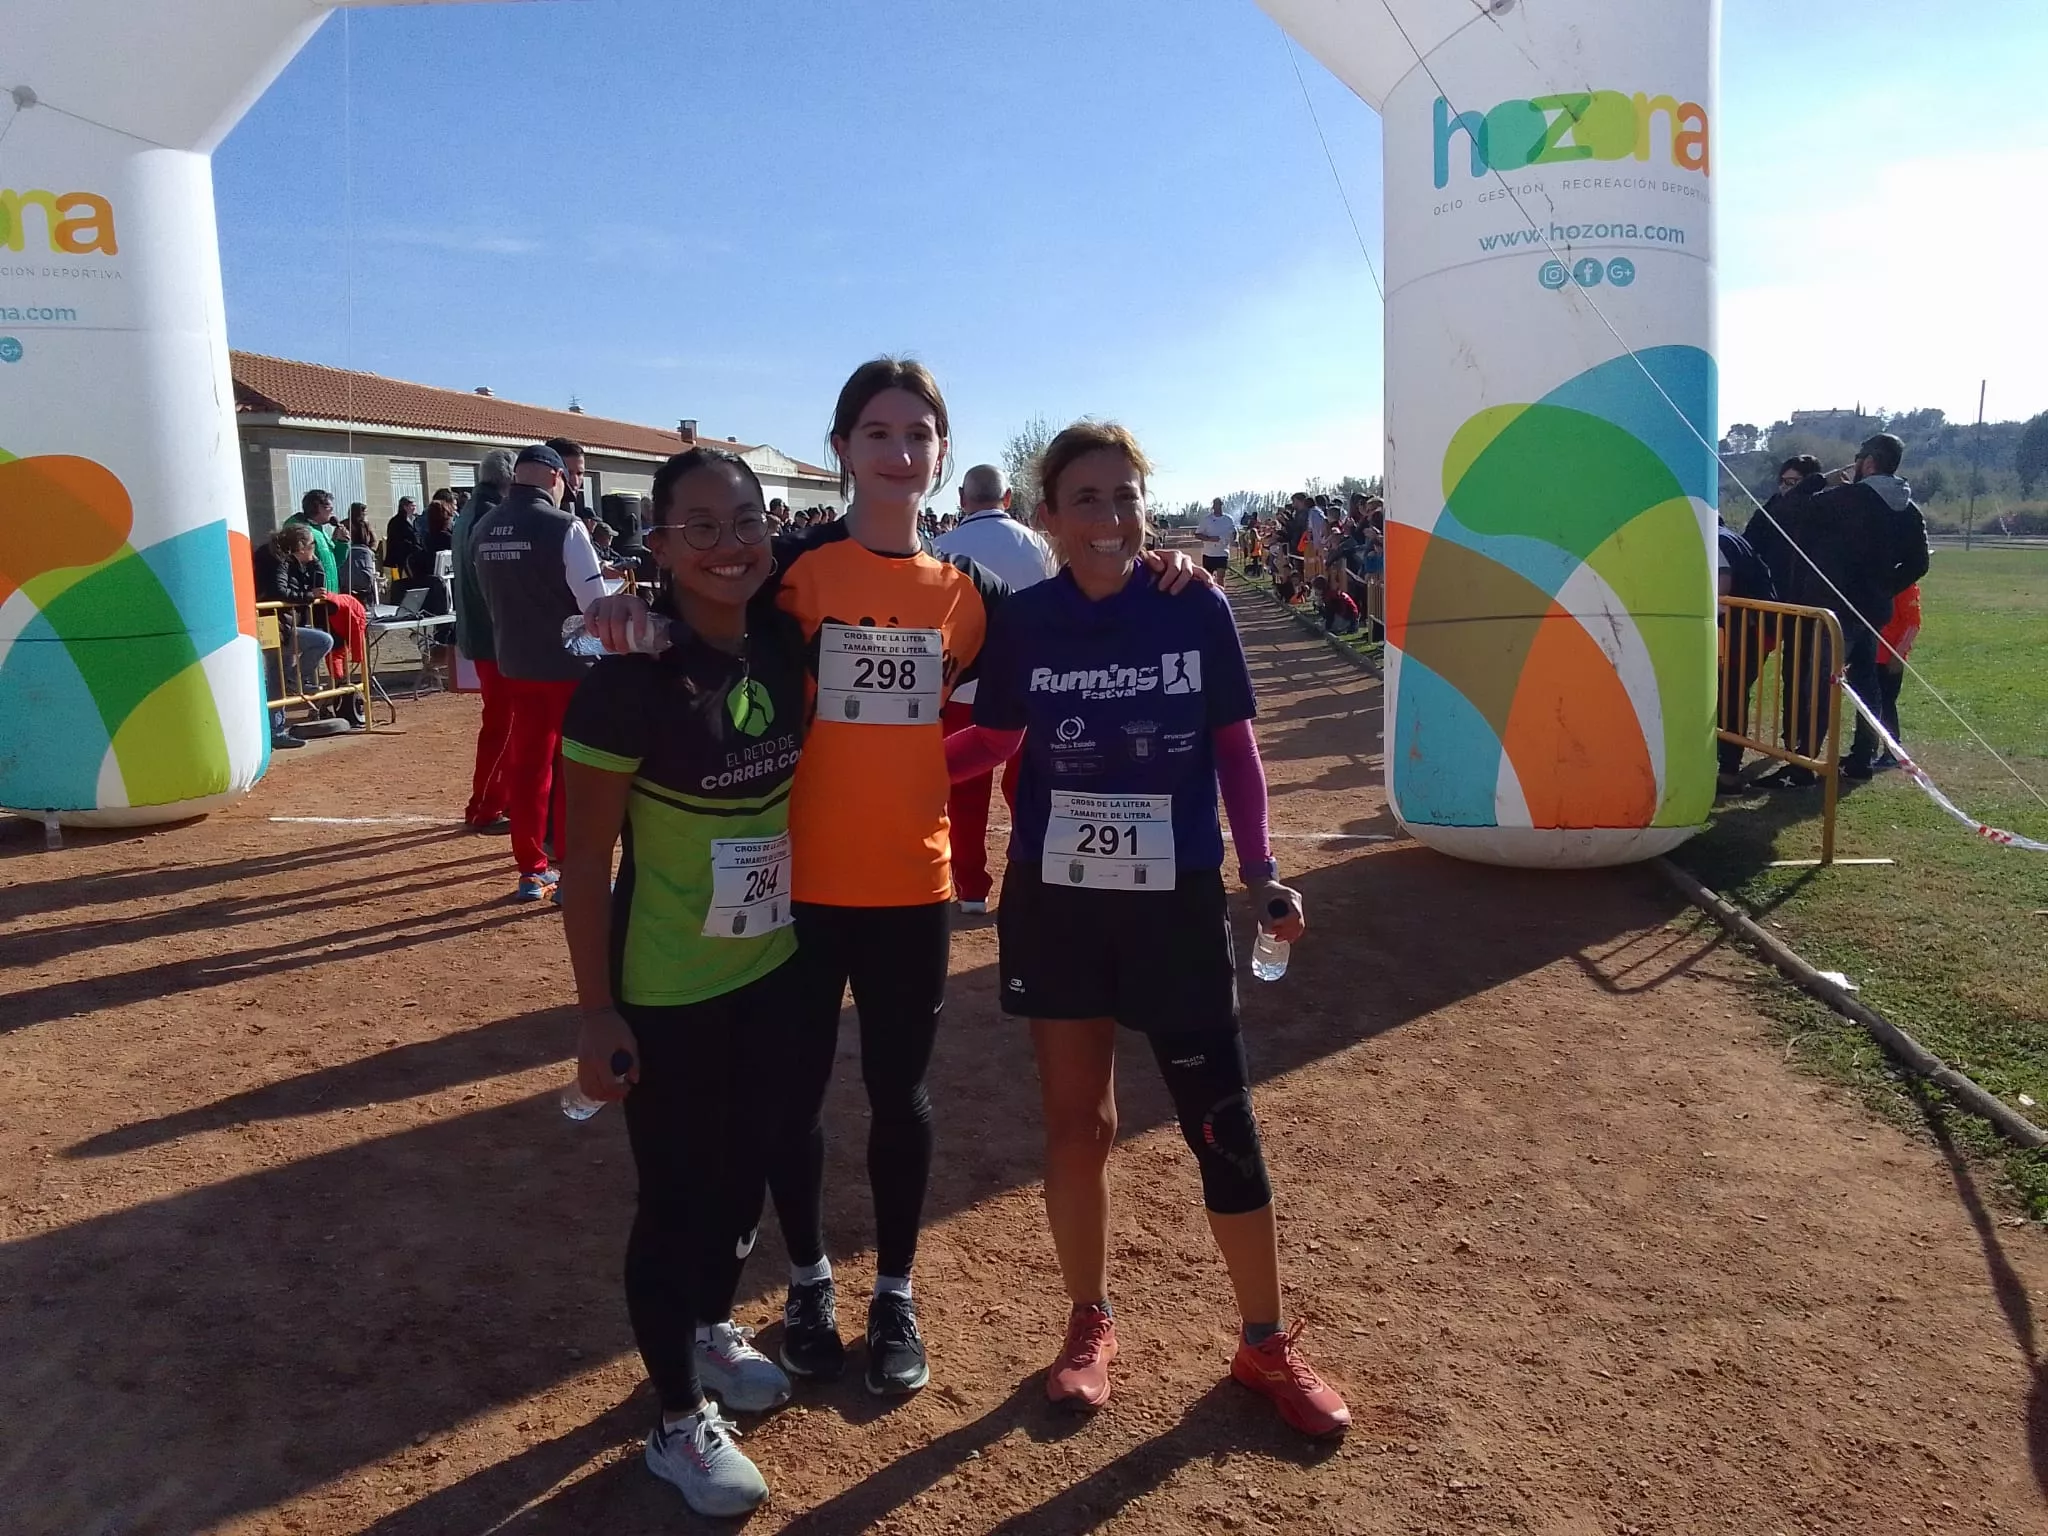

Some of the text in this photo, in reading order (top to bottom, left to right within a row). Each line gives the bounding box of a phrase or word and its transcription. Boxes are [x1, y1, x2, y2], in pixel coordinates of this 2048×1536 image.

[1433, 89, 1709, 189] hozona
[1433, 199, 1463, 216] OCIO
[1478, 221, 1685, 252] www.hozona.com
[42, 267, 123, 280] DEPORTIVA
[490, 525, 514, 536] JUEZ
[844, 631, 874, 641] CROSS
[876, 633, 887, 641] DE
[889, 634, 900, 642] LA
[842, 643, 886, 653] TAMARITE
[902, 646, 928, 654] LITERA
[853, 658, 916, 690] 298
[726, 734, 795, 768] EL RETO DE
[701, 748, 803, 790] CORRER.CO
[1071, 798, 1095, 807] CROSS
[1110, 800, 1120, 808] LA
[1122, 800, 1151, 808] LITERA
[1070, 809, 1107, 819] TAMARITE
[1076, 823, 1137, 856] 291
[735, 845, 762, 853] CROSS
[743, 863, 780, 903] 284
